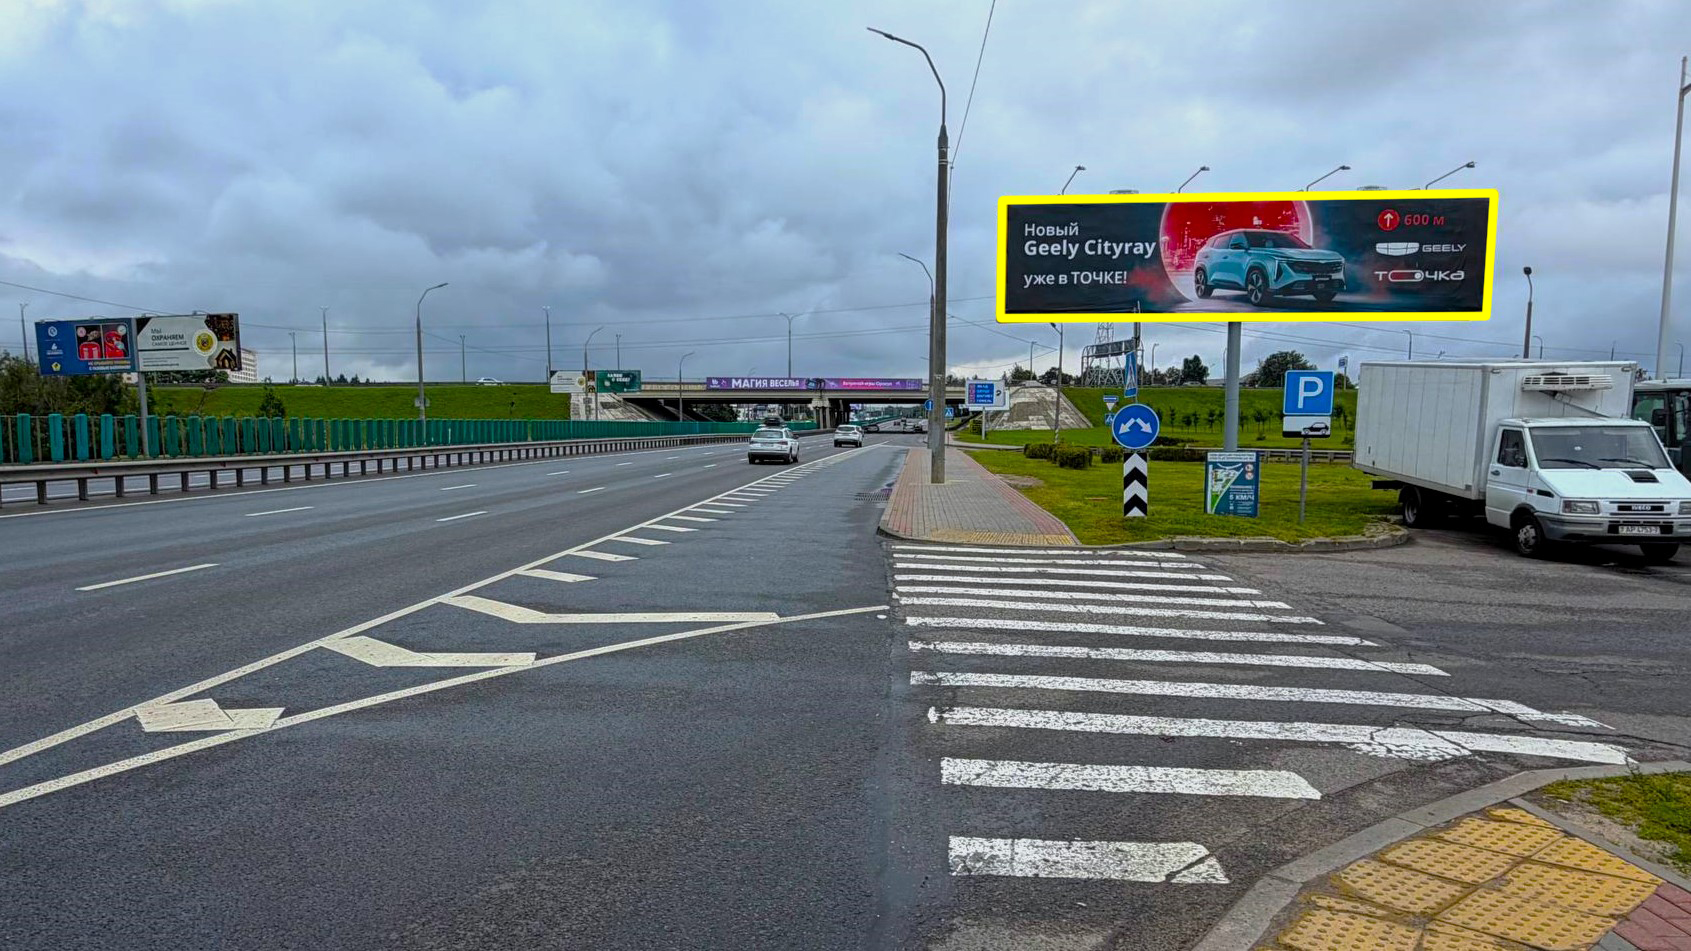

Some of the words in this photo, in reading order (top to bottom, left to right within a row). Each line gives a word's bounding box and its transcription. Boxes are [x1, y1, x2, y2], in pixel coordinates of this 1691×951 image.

[1404, 214, 1429, 225] 600
[1024, 222, 1079, 236] Новый
[1024, 239, 1079, 259] Geely
[1084, 238, 1156, 259] Cityray
[1422, 244, 1467, 252] GEELY
[1024, 273, 1055, 288] уже
[1058, 274, 1068, 284] в
[1070, 271, 1127, 285] ТОЧКЕ!
[731, 378, 768, 388] МАГИЯ
[769, 379, 799, 387] ВЕСЕЛЬЯ
[1297, 376, 1324, 409] P
